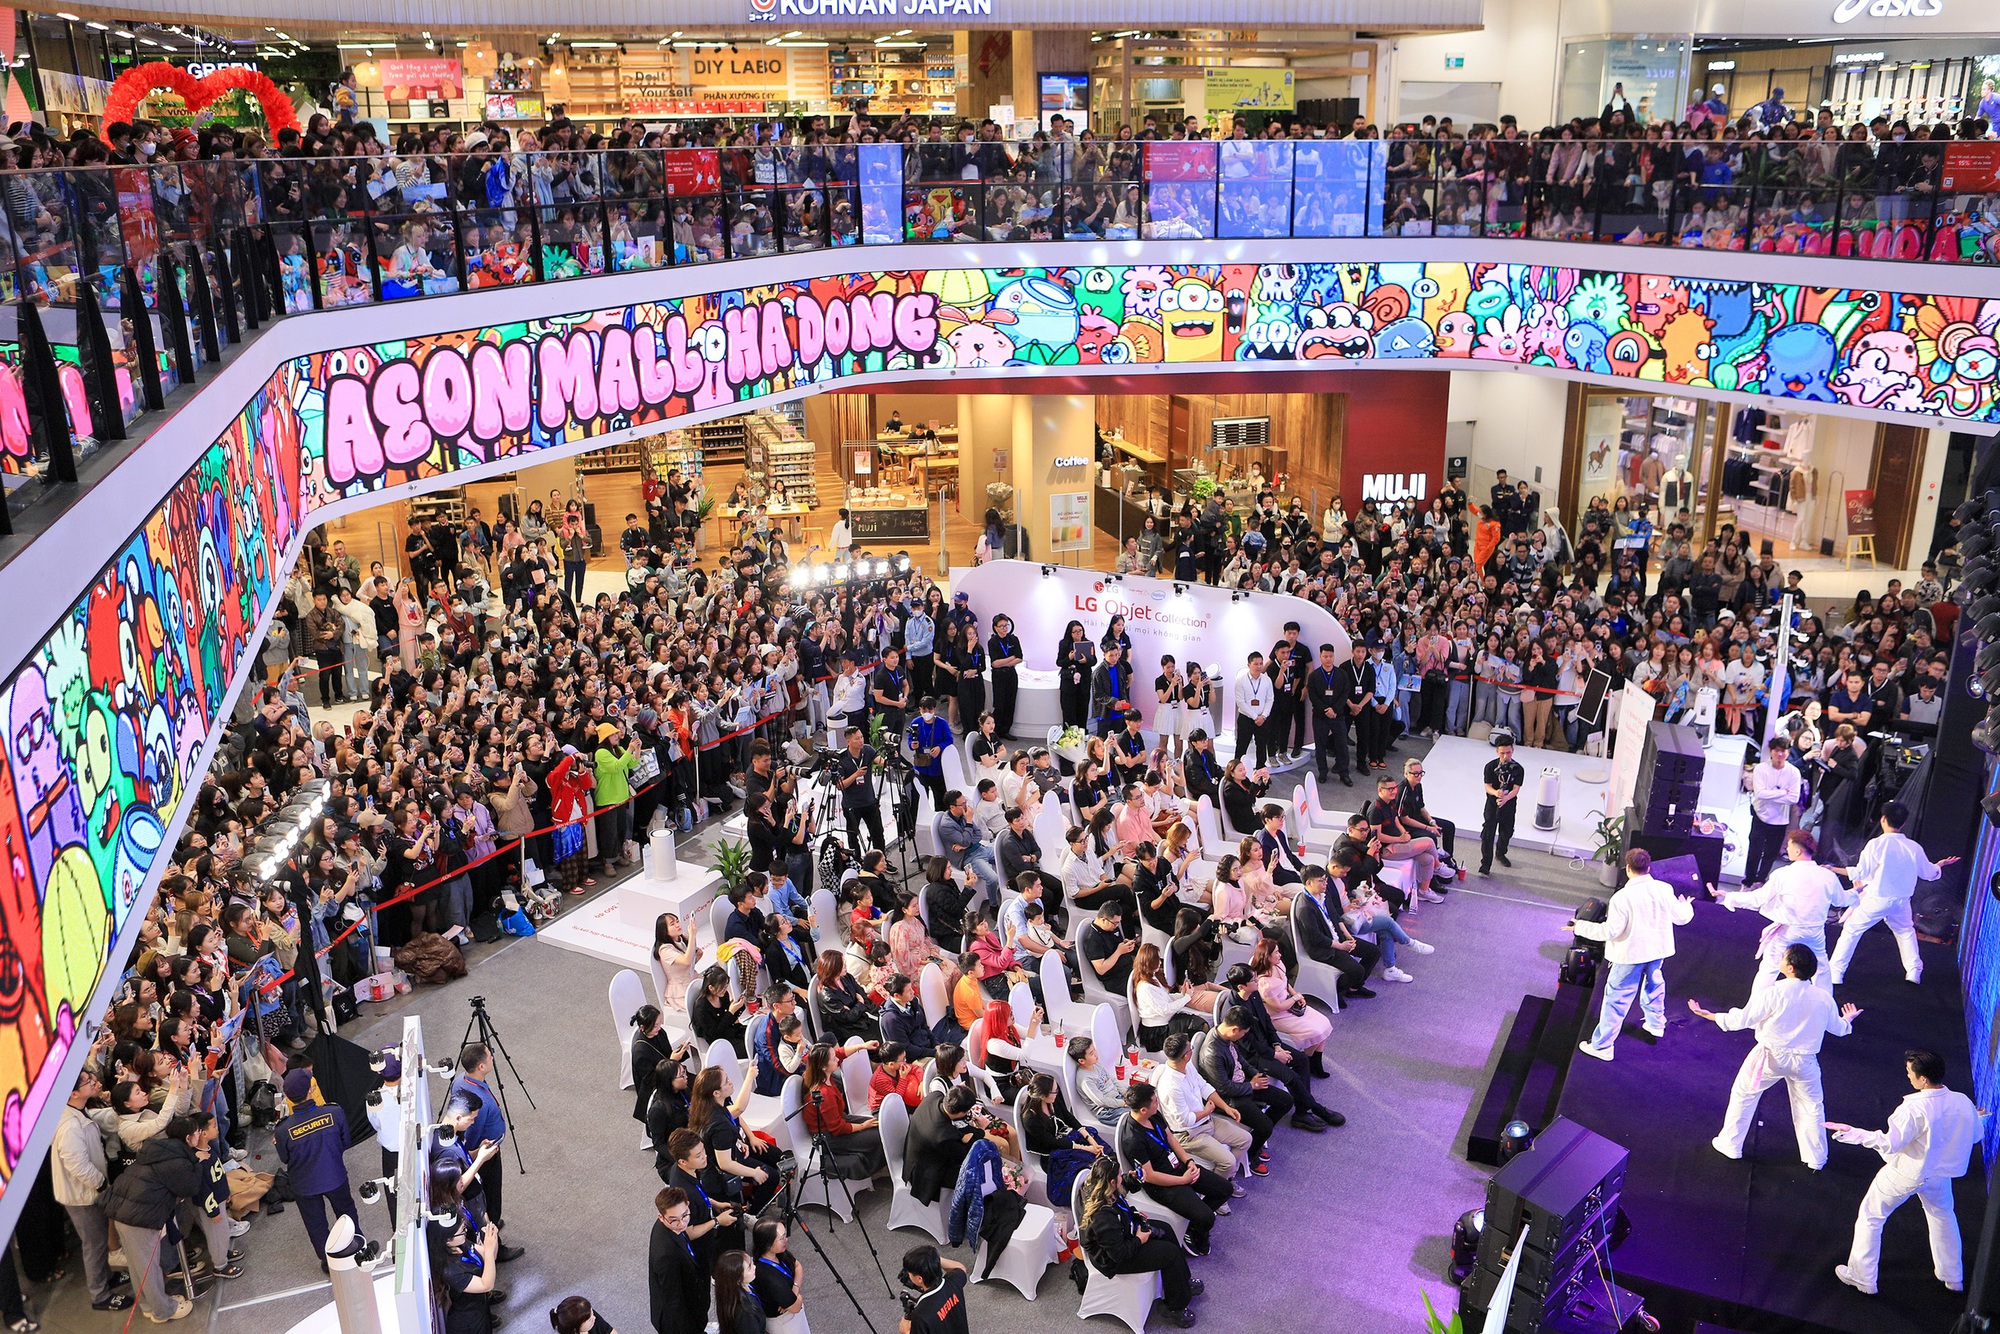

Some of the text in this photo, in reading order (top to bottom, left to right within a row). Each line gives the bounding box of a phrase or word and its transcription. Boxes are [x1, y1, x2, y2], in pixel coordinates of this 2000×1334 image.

[780, 0, 991, 15] KOHNAN JAPAN
[748, 13, 777, 21] コーナン
[694, 59, 782, 74] DIY LABO
[639, 87, 694, 98] Yourself
[325, 290, 941, 484] AEON MALL HA DONG
[1055, 456, 1089, 468] Coffee
[1363, 473, 1426, 501] MUJI
[1106, 585, 1119, 594] LG
[1075, 595, 1207, 629] LG Objet Collection
[1083, 618, 1098, 627] Hài
[1134, 626, 1150, 635] mọi
[1153, 629, 1180, 641] không
[1183, 634, 1201, 642] gian
[292, 1116, 330, 1137] SECURITY
[936, 1293, 960, 1322] MEDIA
